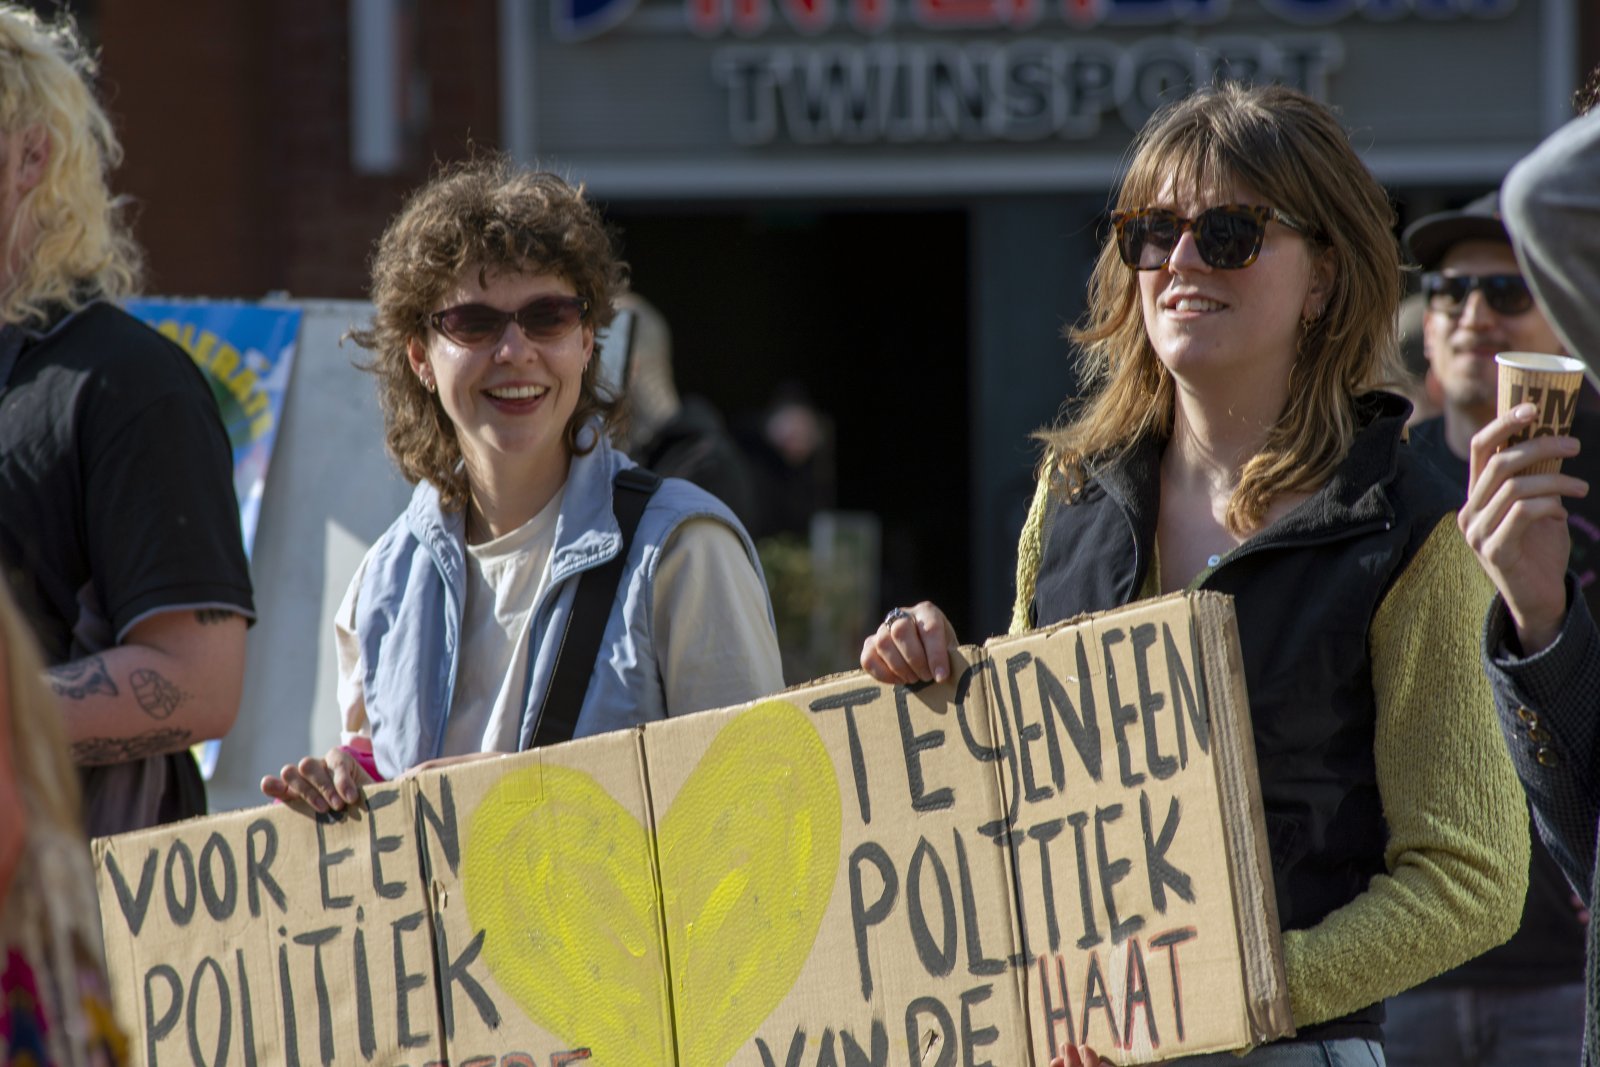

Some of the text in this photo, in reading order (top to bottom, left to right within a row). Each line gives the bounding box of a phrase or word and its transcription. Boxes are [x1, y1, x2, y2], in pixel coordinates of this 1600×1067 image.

[104, 773, 461, 937] VOOR EEN
[848, 790, 1197, 1001] POLITIEK
[904, 983, 999, 1067] DE
[1037, 925, 1198, 1060] HAAT
